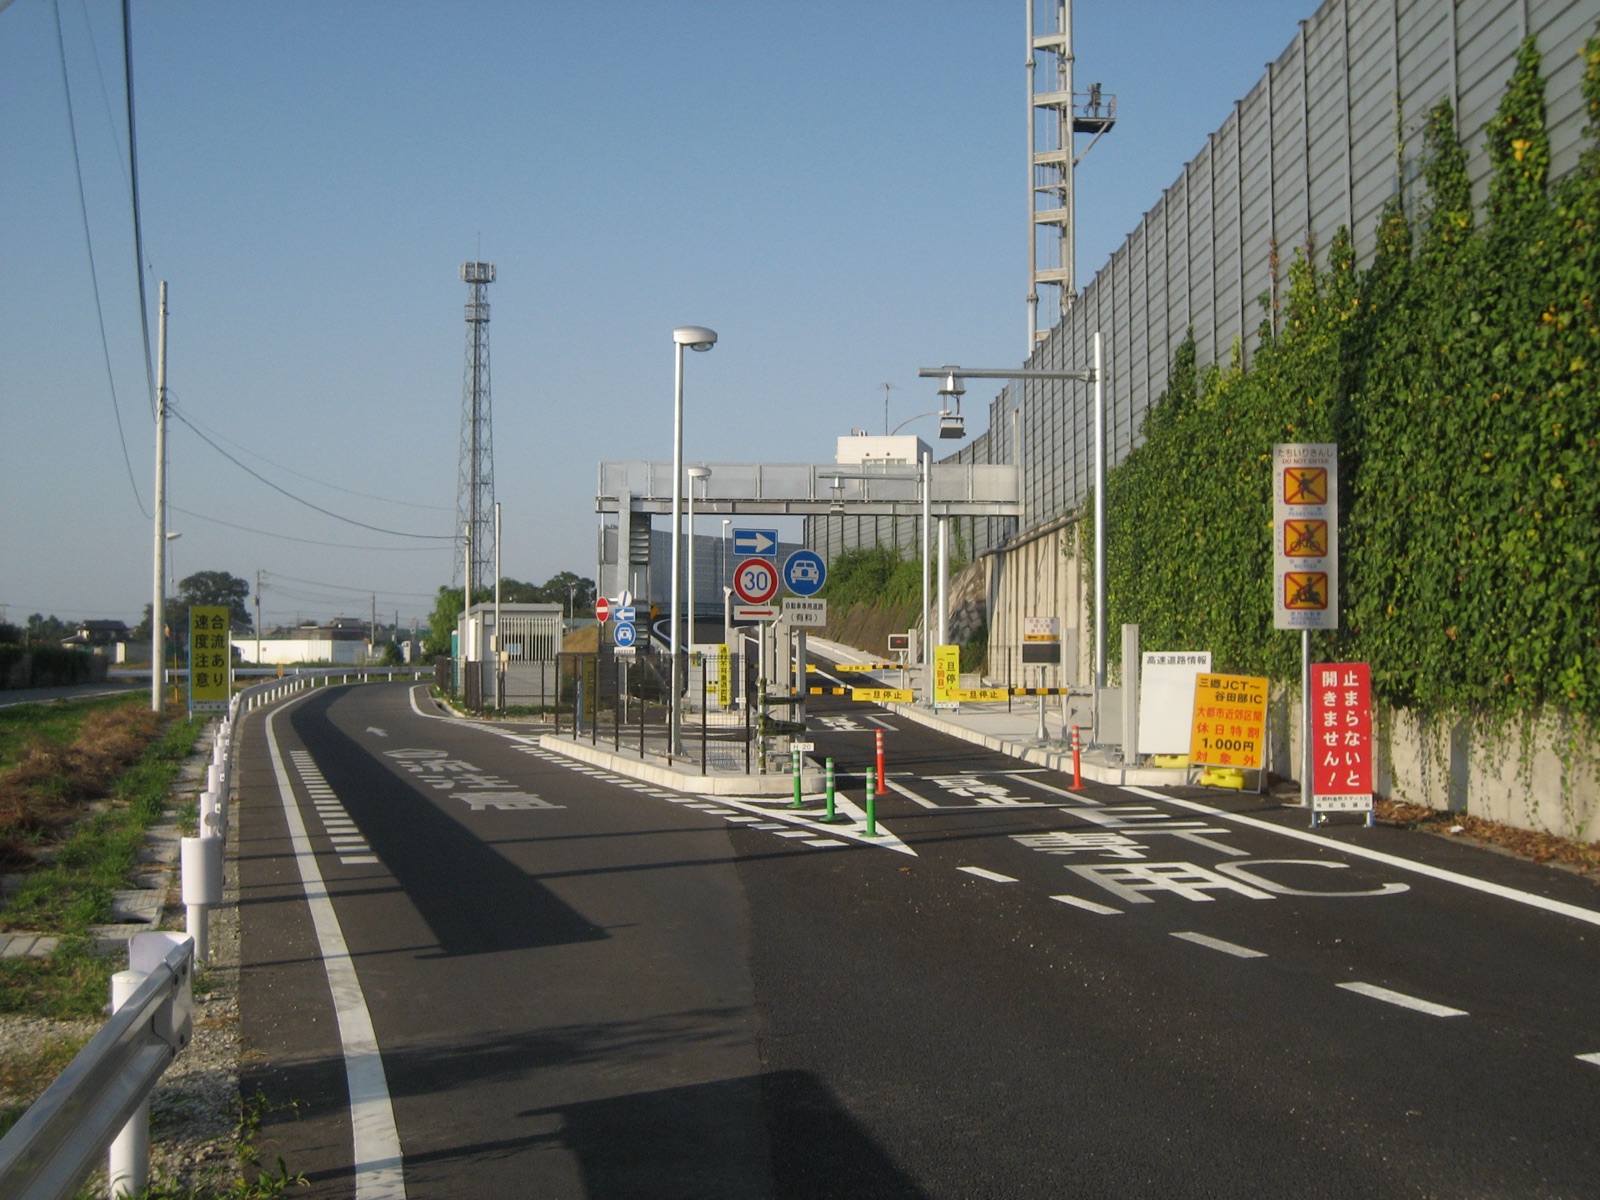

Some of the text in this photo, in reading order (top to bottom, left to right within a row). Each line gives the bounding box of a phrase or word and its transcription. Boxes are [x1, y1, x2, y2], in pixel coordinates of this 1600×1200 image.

[1278, 448, 1333, 458] たちいりきんし
[744, 571, 768, 591] 30
[785, 602, 824, 610] 自動車専用道路
[194, 614, 209, 688] 速度注意
[211, 614, 225, 686] 合流あり
[1147, 655, 1207, 665] 高速道路情報
[862, 690, 902, 699] 一旦停止
[959, 690, 998, 699] 一旦停止
[1215, 692, 1263, 704] 谷田部IC
[1197, 707, 1262, 722] 大都市近郊区間
[1197, 722, 1260, 739] 休日特割
[1322, 671, 1339, 787] 開きません！
[1343, 670, 1361, 787] 止まらないと
[1196, 751, 1256, 766] 対象外
